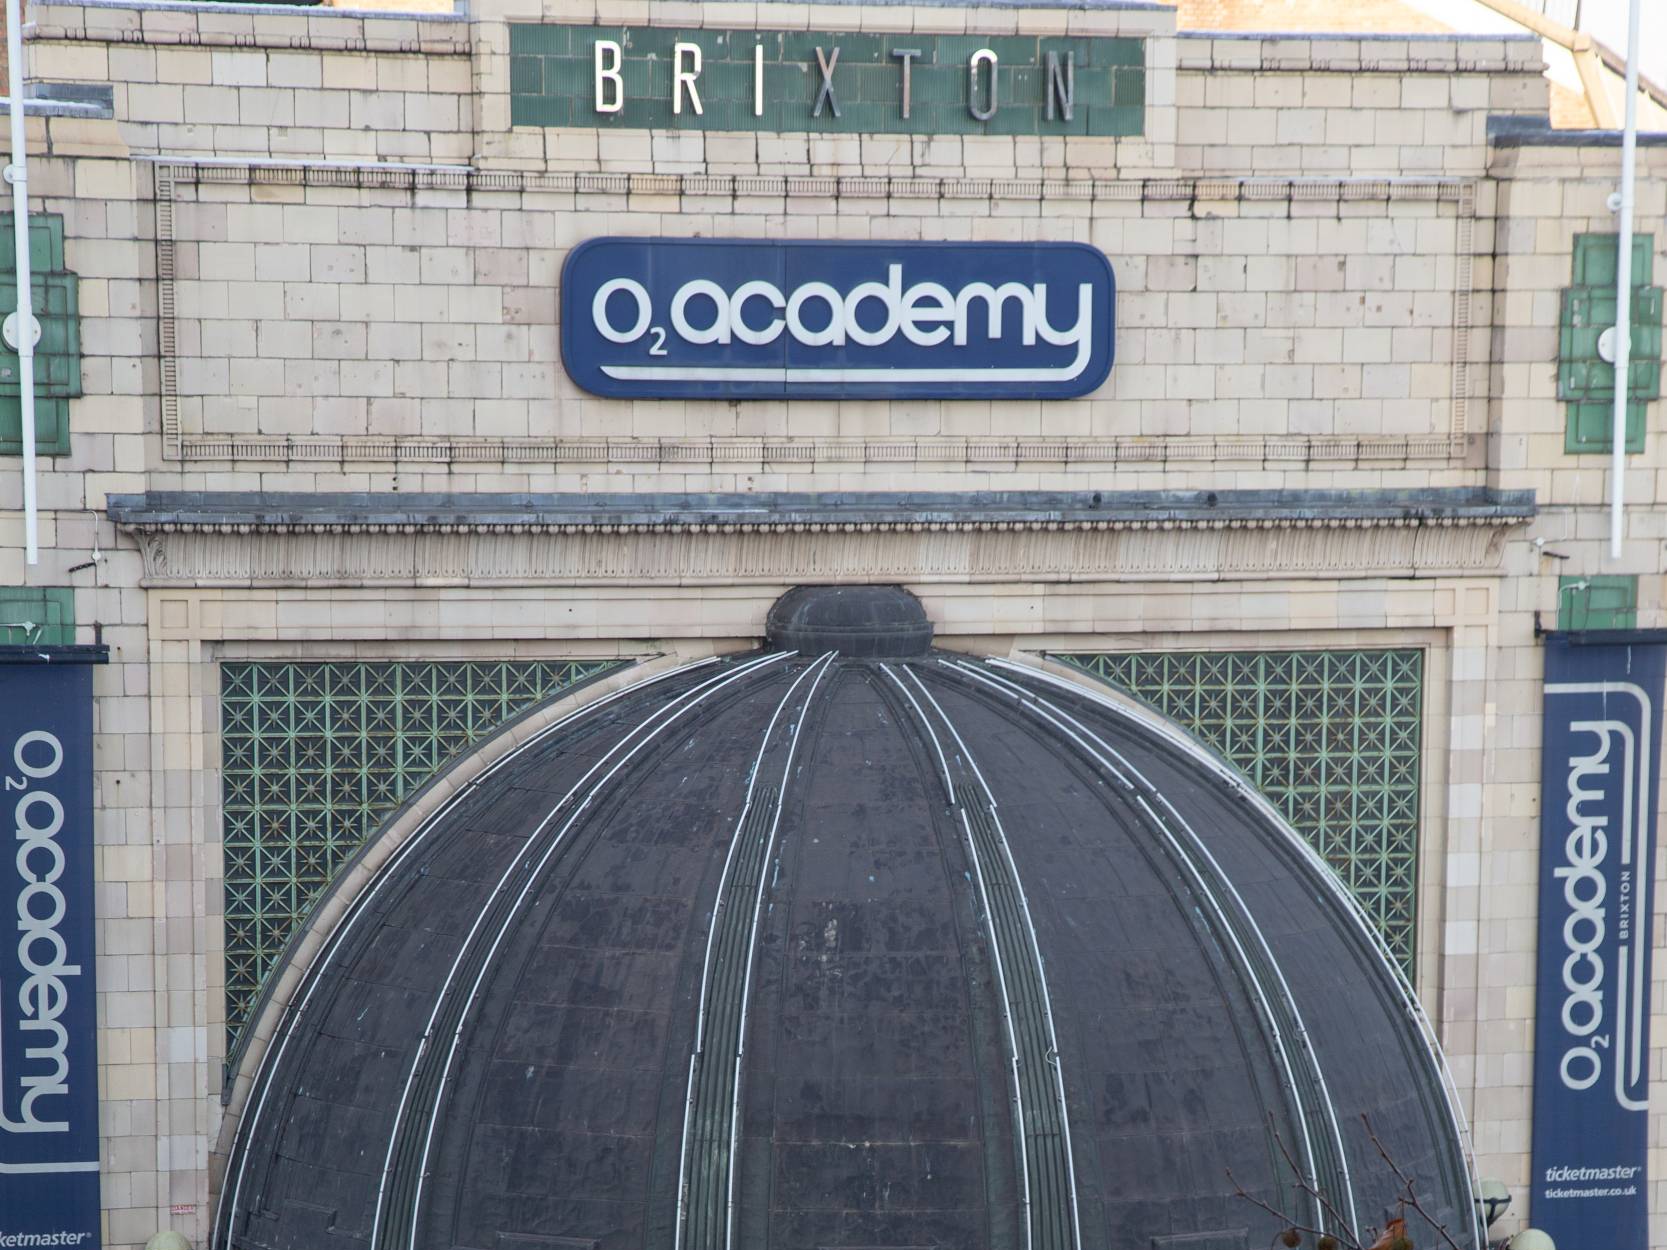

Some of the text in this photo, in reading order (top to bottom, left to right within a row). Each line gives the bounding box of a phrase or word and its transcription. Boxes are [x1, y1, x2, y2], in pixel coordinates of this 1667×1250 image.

[595, 39, 1074, 122] BRIXTON
[1618, 870, 1631, 940] BRIXTON
[1544, 1185, 1637, 1199] ticketmaster.co.uk
